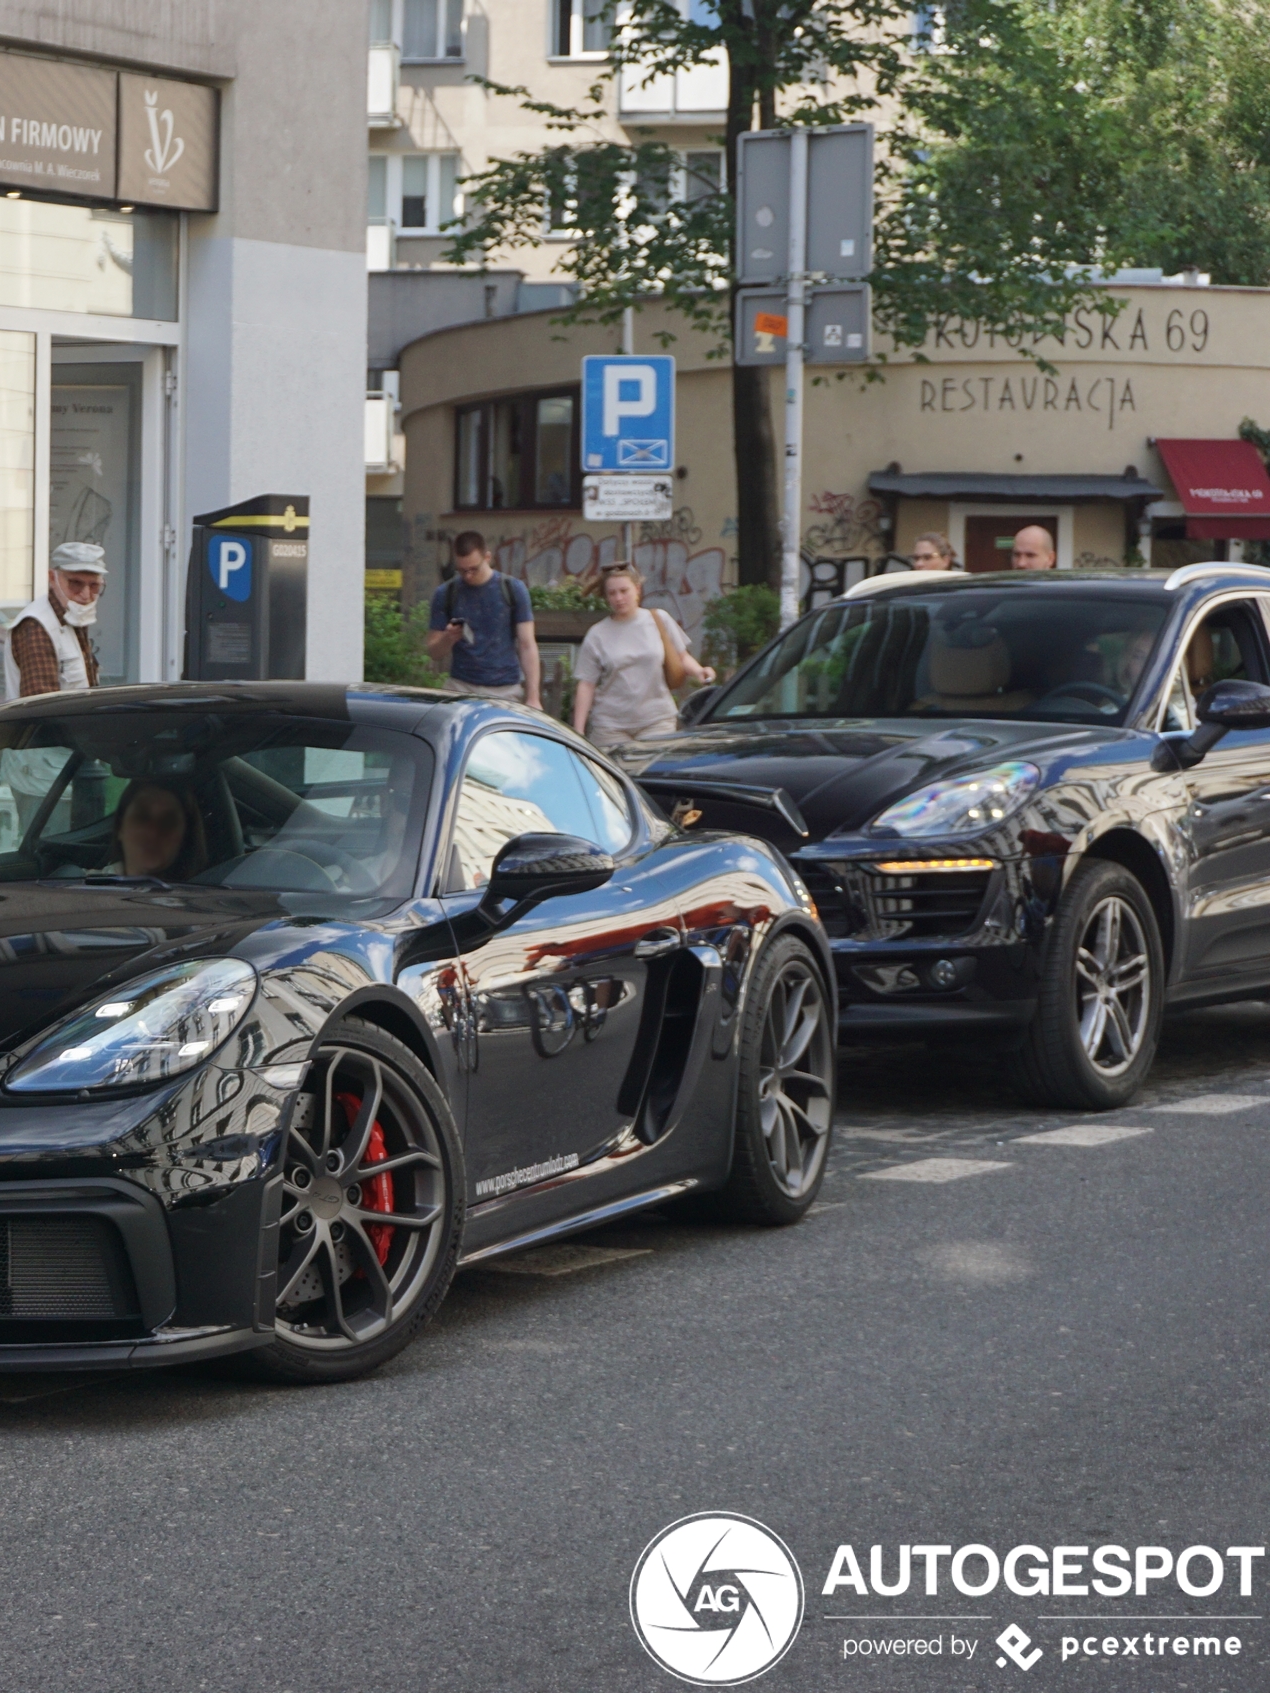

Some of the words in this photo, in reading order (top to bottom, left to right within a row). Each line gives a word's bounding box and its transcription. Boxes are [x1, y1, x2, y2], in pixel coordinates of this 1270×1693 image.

[10, 117, 103, 154] FIRMOWY
[34, 161, 46, 175] M.
[46, 162, 56, 176] A.
[57, 163, 101, 182] Wieczorek
[1166, 309, 1209, 351] 69
[603, 365, 657, 437] P
[920, 377, 1136, 431] RESTAURACJA
[219, 541, 247, 589] P
[475, 1152, 580, 1196] www.porschecentrumlodz.com
